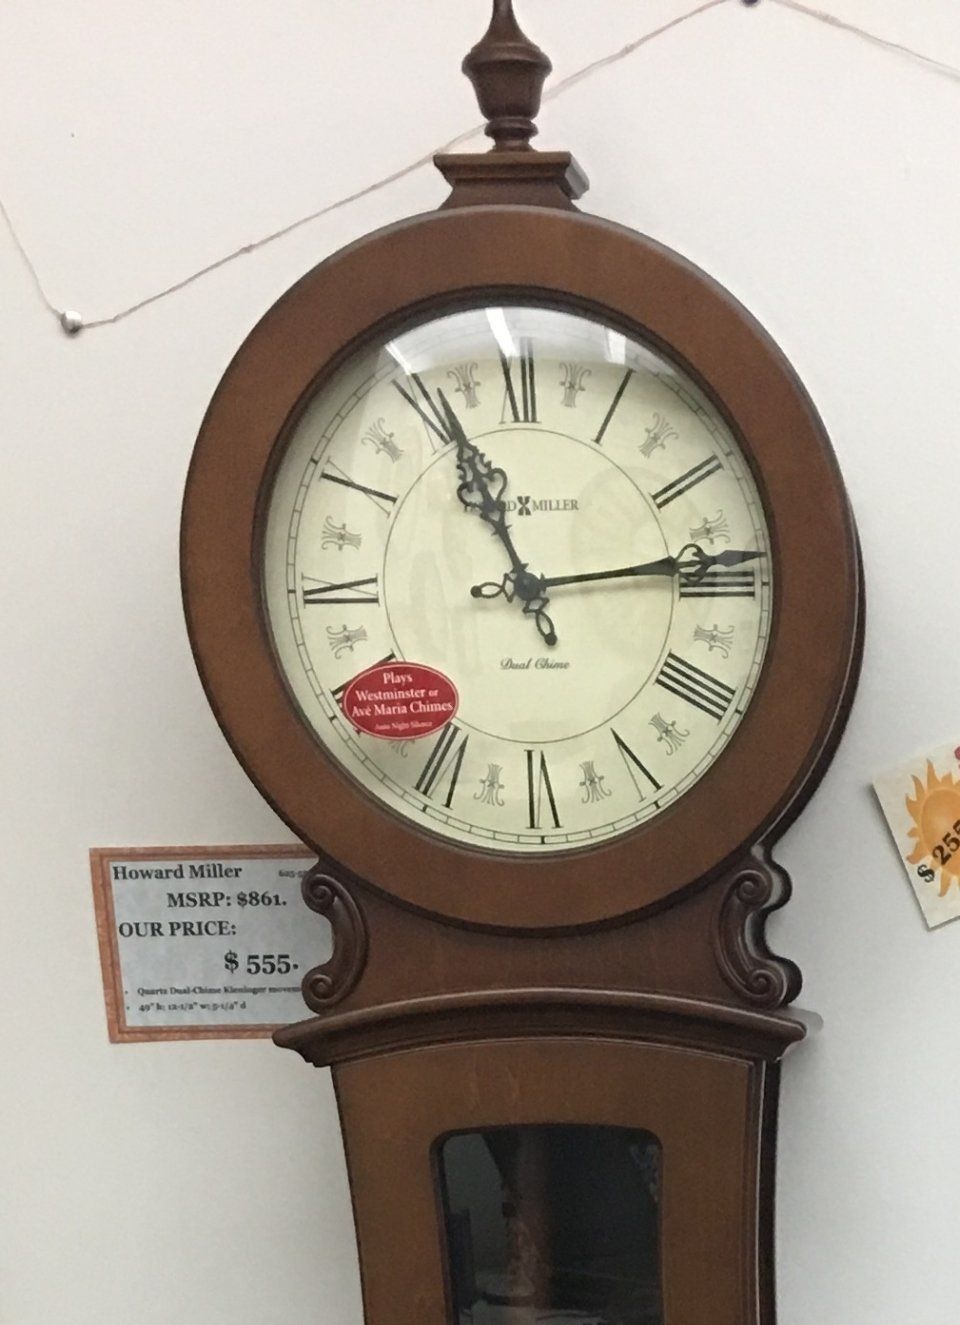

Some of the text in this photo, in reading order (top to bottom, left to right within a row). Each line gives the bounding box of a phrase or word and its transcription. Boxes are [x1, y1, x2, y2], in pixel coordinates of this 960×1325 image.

[532, 499, 579, 512] MILLER
[500, 657, 570, 670] Dual Chime
[383, 672, 413, 686] Plays
[355, 687, 439, 702] Westminster or
[374, 703, 408, 716] Maria
[410, 700, 453, 713] Chimes
[113, 863, 243, 880] Howard Miller
[916, 863, 935, 884] $
[166, 890, 287, 909] MSRP: $861.
[118, 920, 237, 938] OUR PRICE:
[224, 950, 239, 972] $
[137, 987, 167, 996] Quartz
